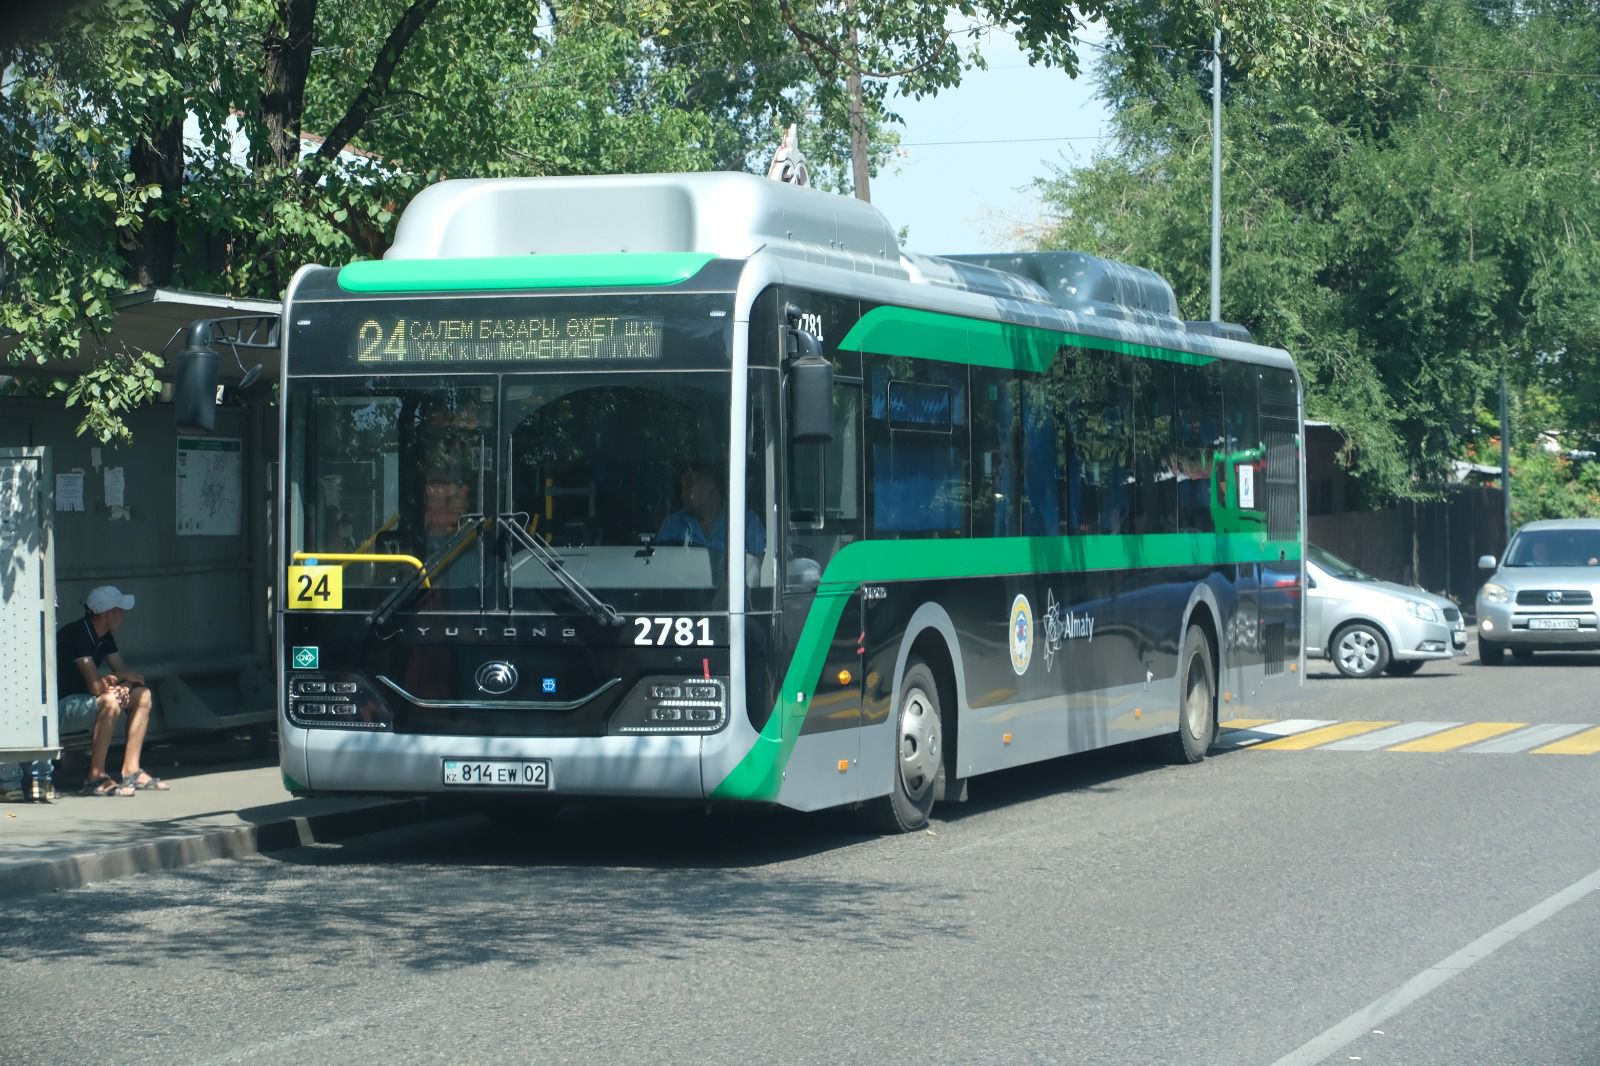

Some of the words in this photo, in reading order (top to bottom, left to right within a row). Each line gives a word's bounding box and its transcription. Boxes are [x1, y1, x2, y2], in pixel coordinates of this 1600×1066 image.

[358, 319, 406, 361] 24
[410, 320, 473, 340] САЛЕМ
[479, 319, 560, 339] БАЗАРЫ,
[566, 317, 619, 337] ӨЖЕТ
[297, 574, 331, 601] 24
[416, 627, 576, 638] YUTONG
[633, 616, 714, 646] 2781
[1064, 611, 1095, 643] Almaty
[446, 773, 457, 782] KZ
[462, 764, 492, 782] 814
[498, 768, 517, 782] EW
[524, 765, 544, 783] 02
